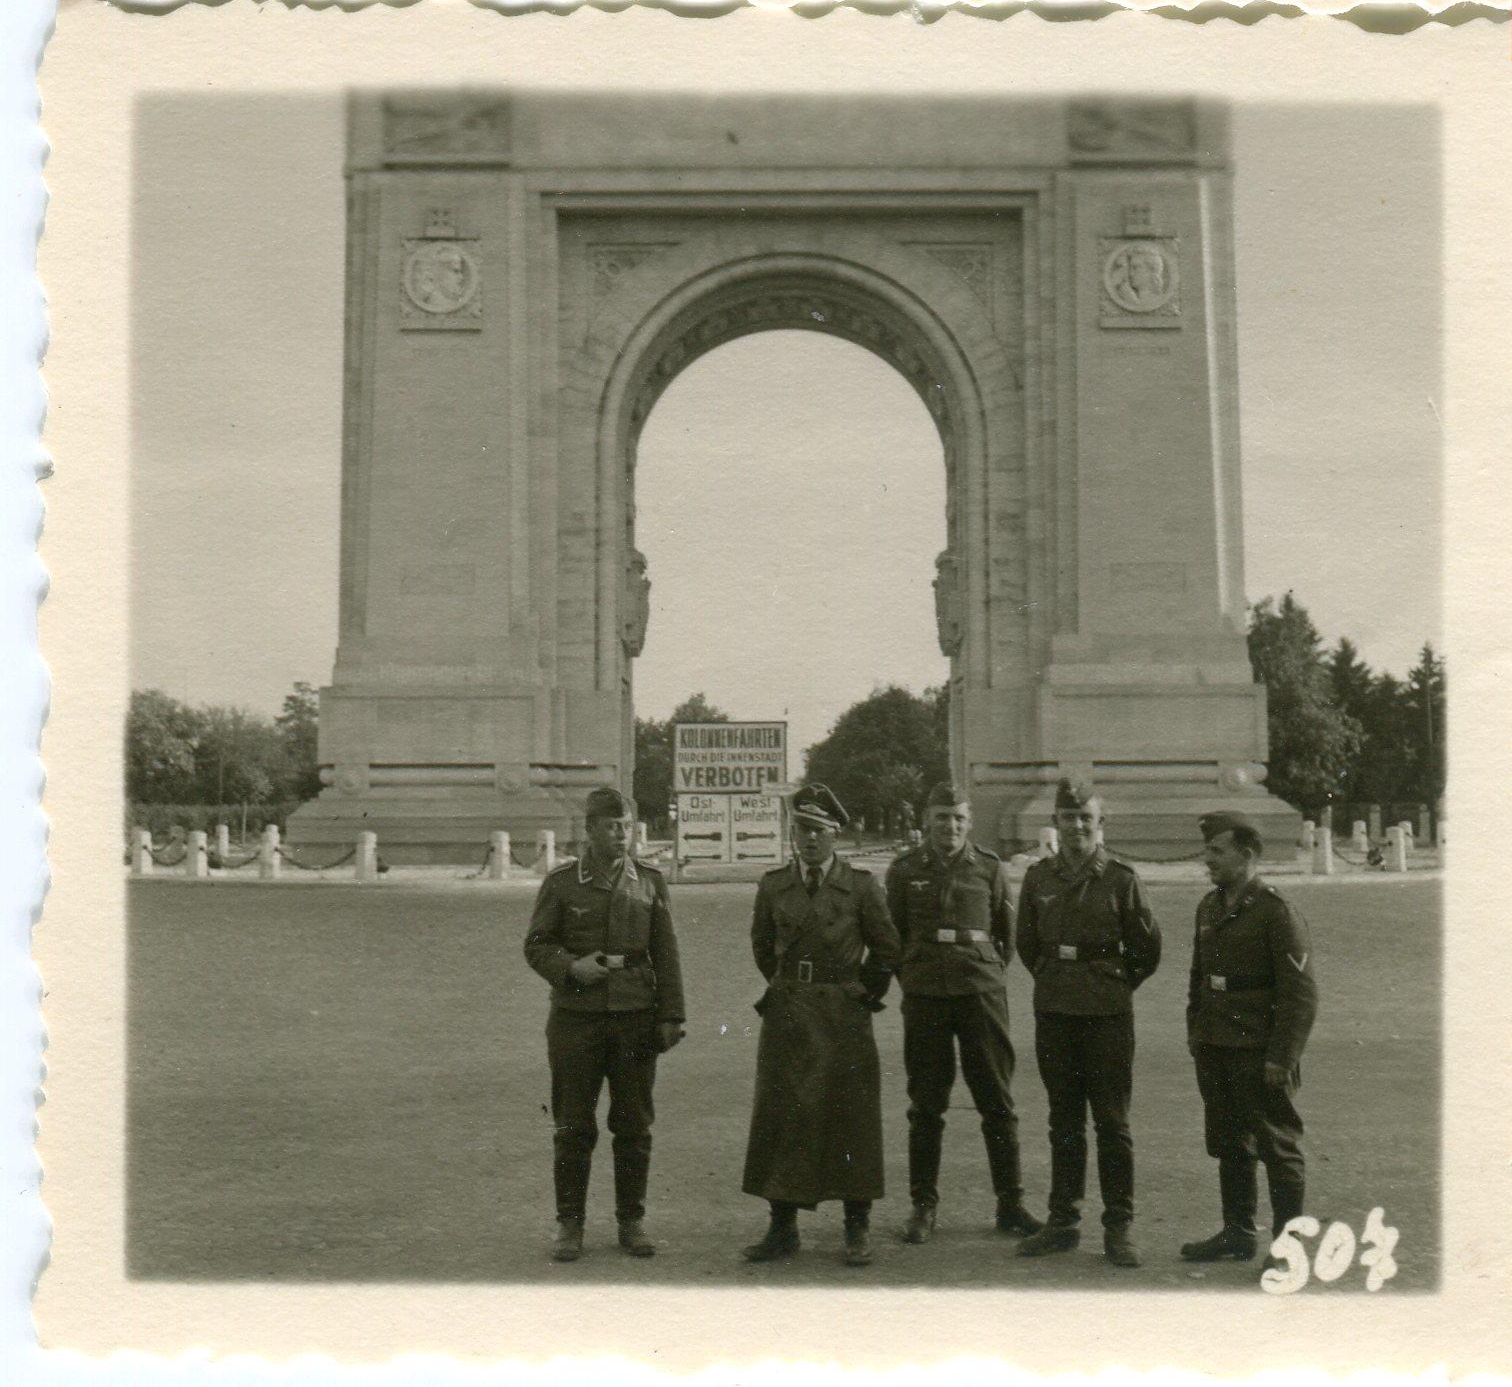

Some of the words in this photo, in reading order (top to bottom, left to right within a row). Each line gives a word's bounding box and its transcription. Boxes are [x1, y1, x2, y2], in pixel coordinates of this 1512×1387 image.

[680, 728, 781, 749] KOLONNENFAHRTEN
[678, 752, 708, 763] DURCH
[710, 752, 726, 763] DIE
[727, 752, 783, 763] INNENSTADT
[680, 766, 779, 788] VERBOTEN
[681, 810, 725, 822] Umfahrt
[734, 809, 778, 822] Umfahrt
